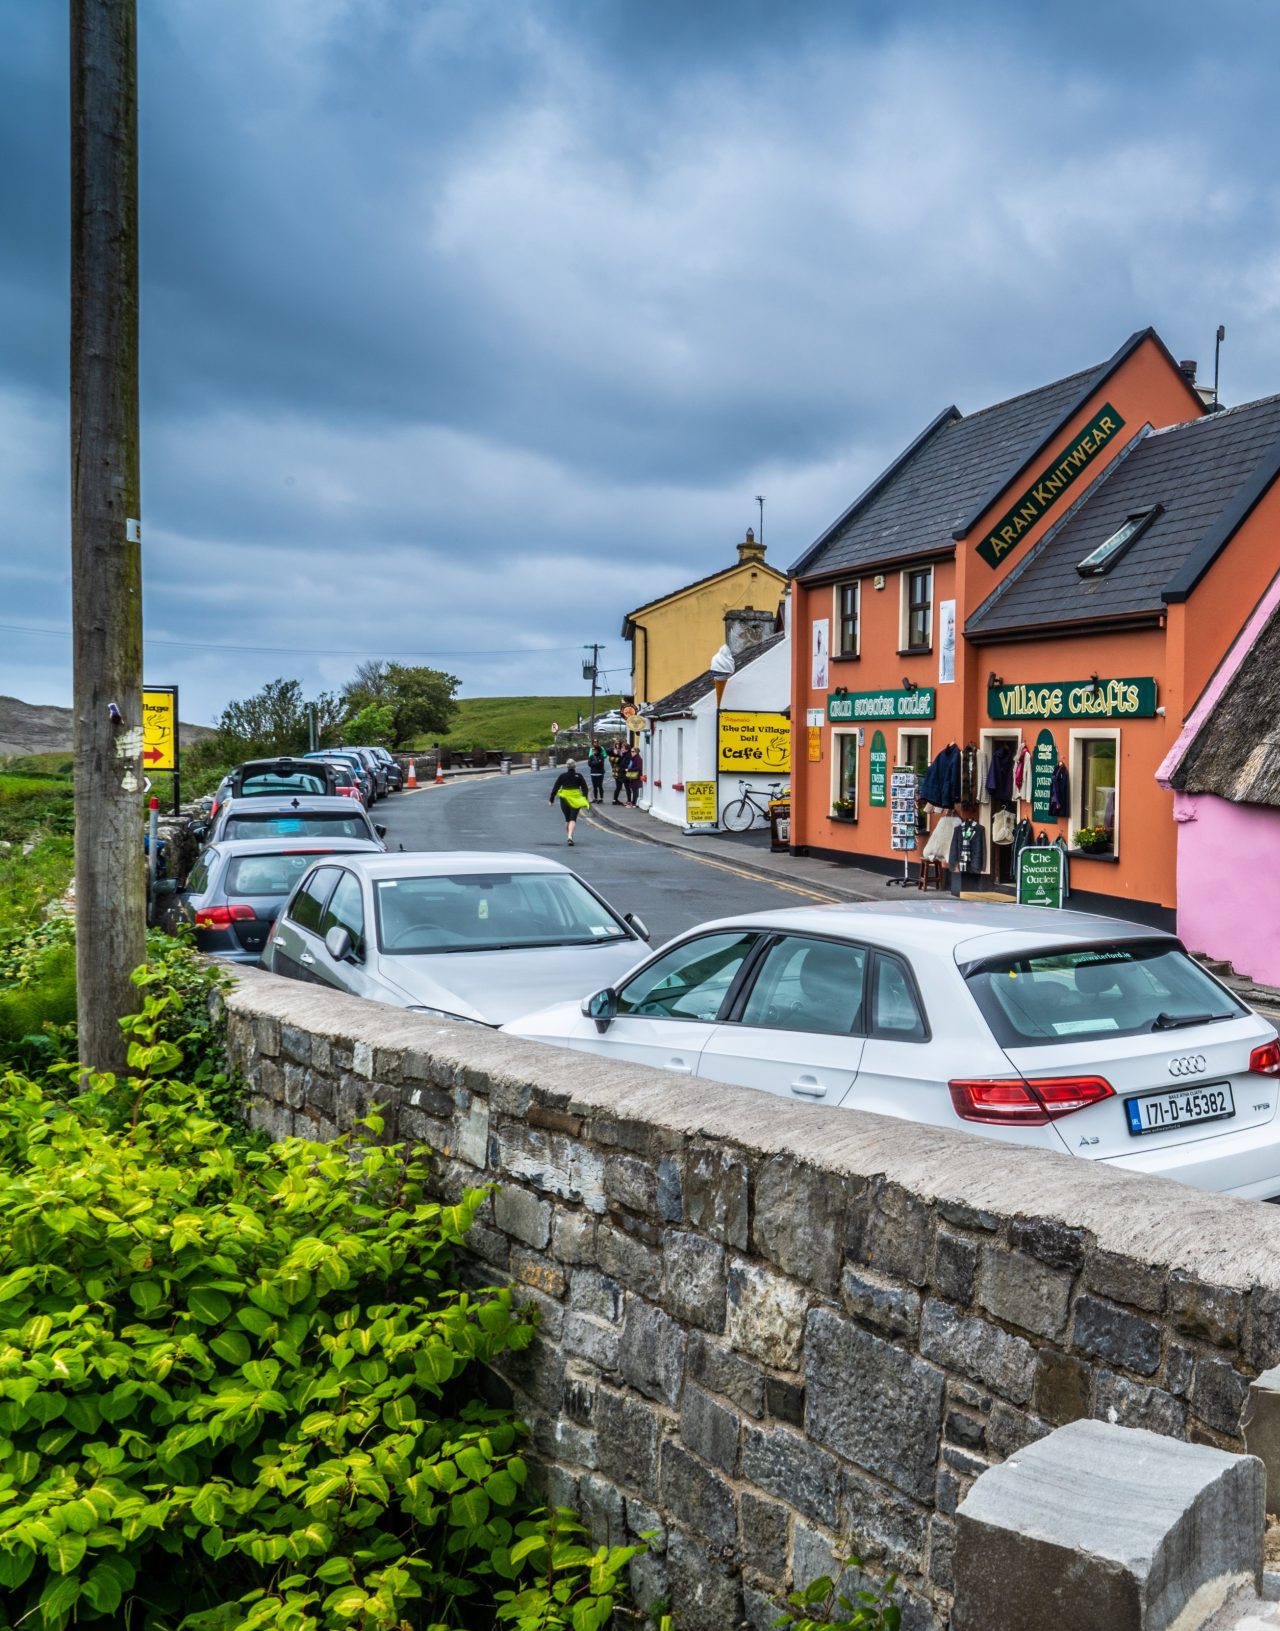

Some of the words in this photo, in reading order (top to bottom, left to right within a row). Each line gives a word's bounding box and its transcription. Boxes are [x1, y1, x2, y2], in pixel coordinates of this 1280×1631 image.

[989, 502, 1039, 558] ARAN
[1032, 416, 1117, 506] KNITWEAR
[758, 726, 791, 734] Village
[722, 747, 763, 759] Café
[1030, 853, 1051, 863] The
[1022, 865, 1058, 873] Sweater
[1026, 875, 1056, 884] Outlet
[1146, 1091, 1227, 1125] 171-D-45382
[1079, 1136, 1100, 1147] A3
